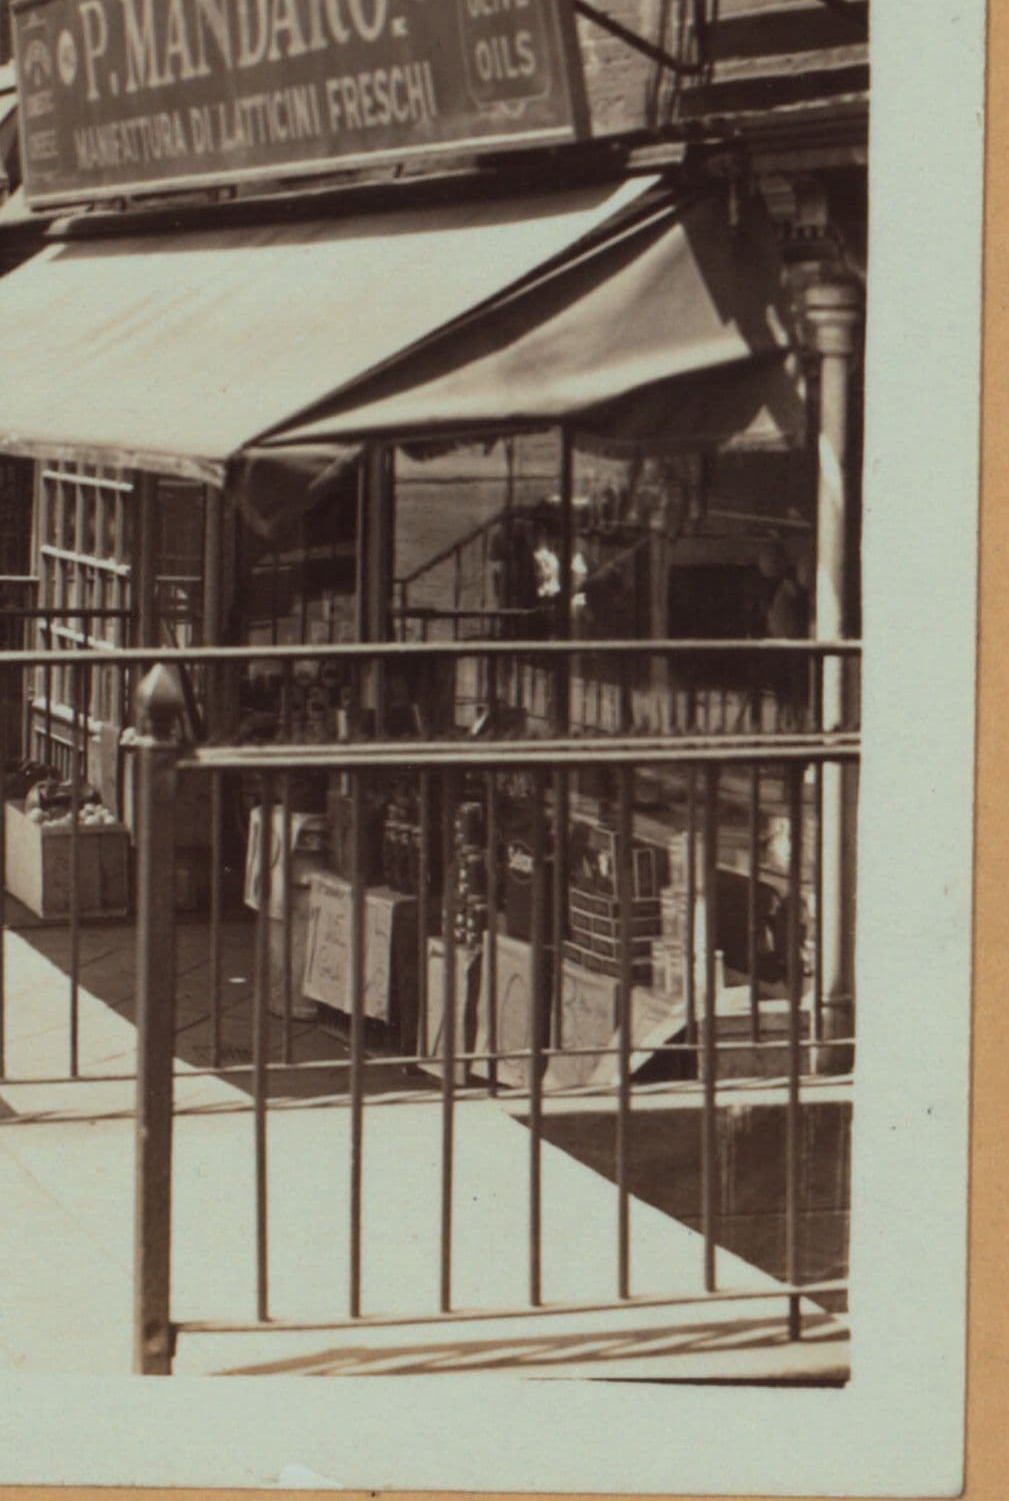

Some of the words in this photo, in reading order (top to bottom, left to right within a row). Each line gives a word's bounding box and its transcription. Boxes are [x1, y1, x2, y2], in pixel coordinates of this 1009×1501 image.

[474, 31, 537, 81] OILS
[190, 106, 216, 154] DI
[218, 82, 323, 152] LATTICINI
[325, 61, 437, 134] FRESCHI
